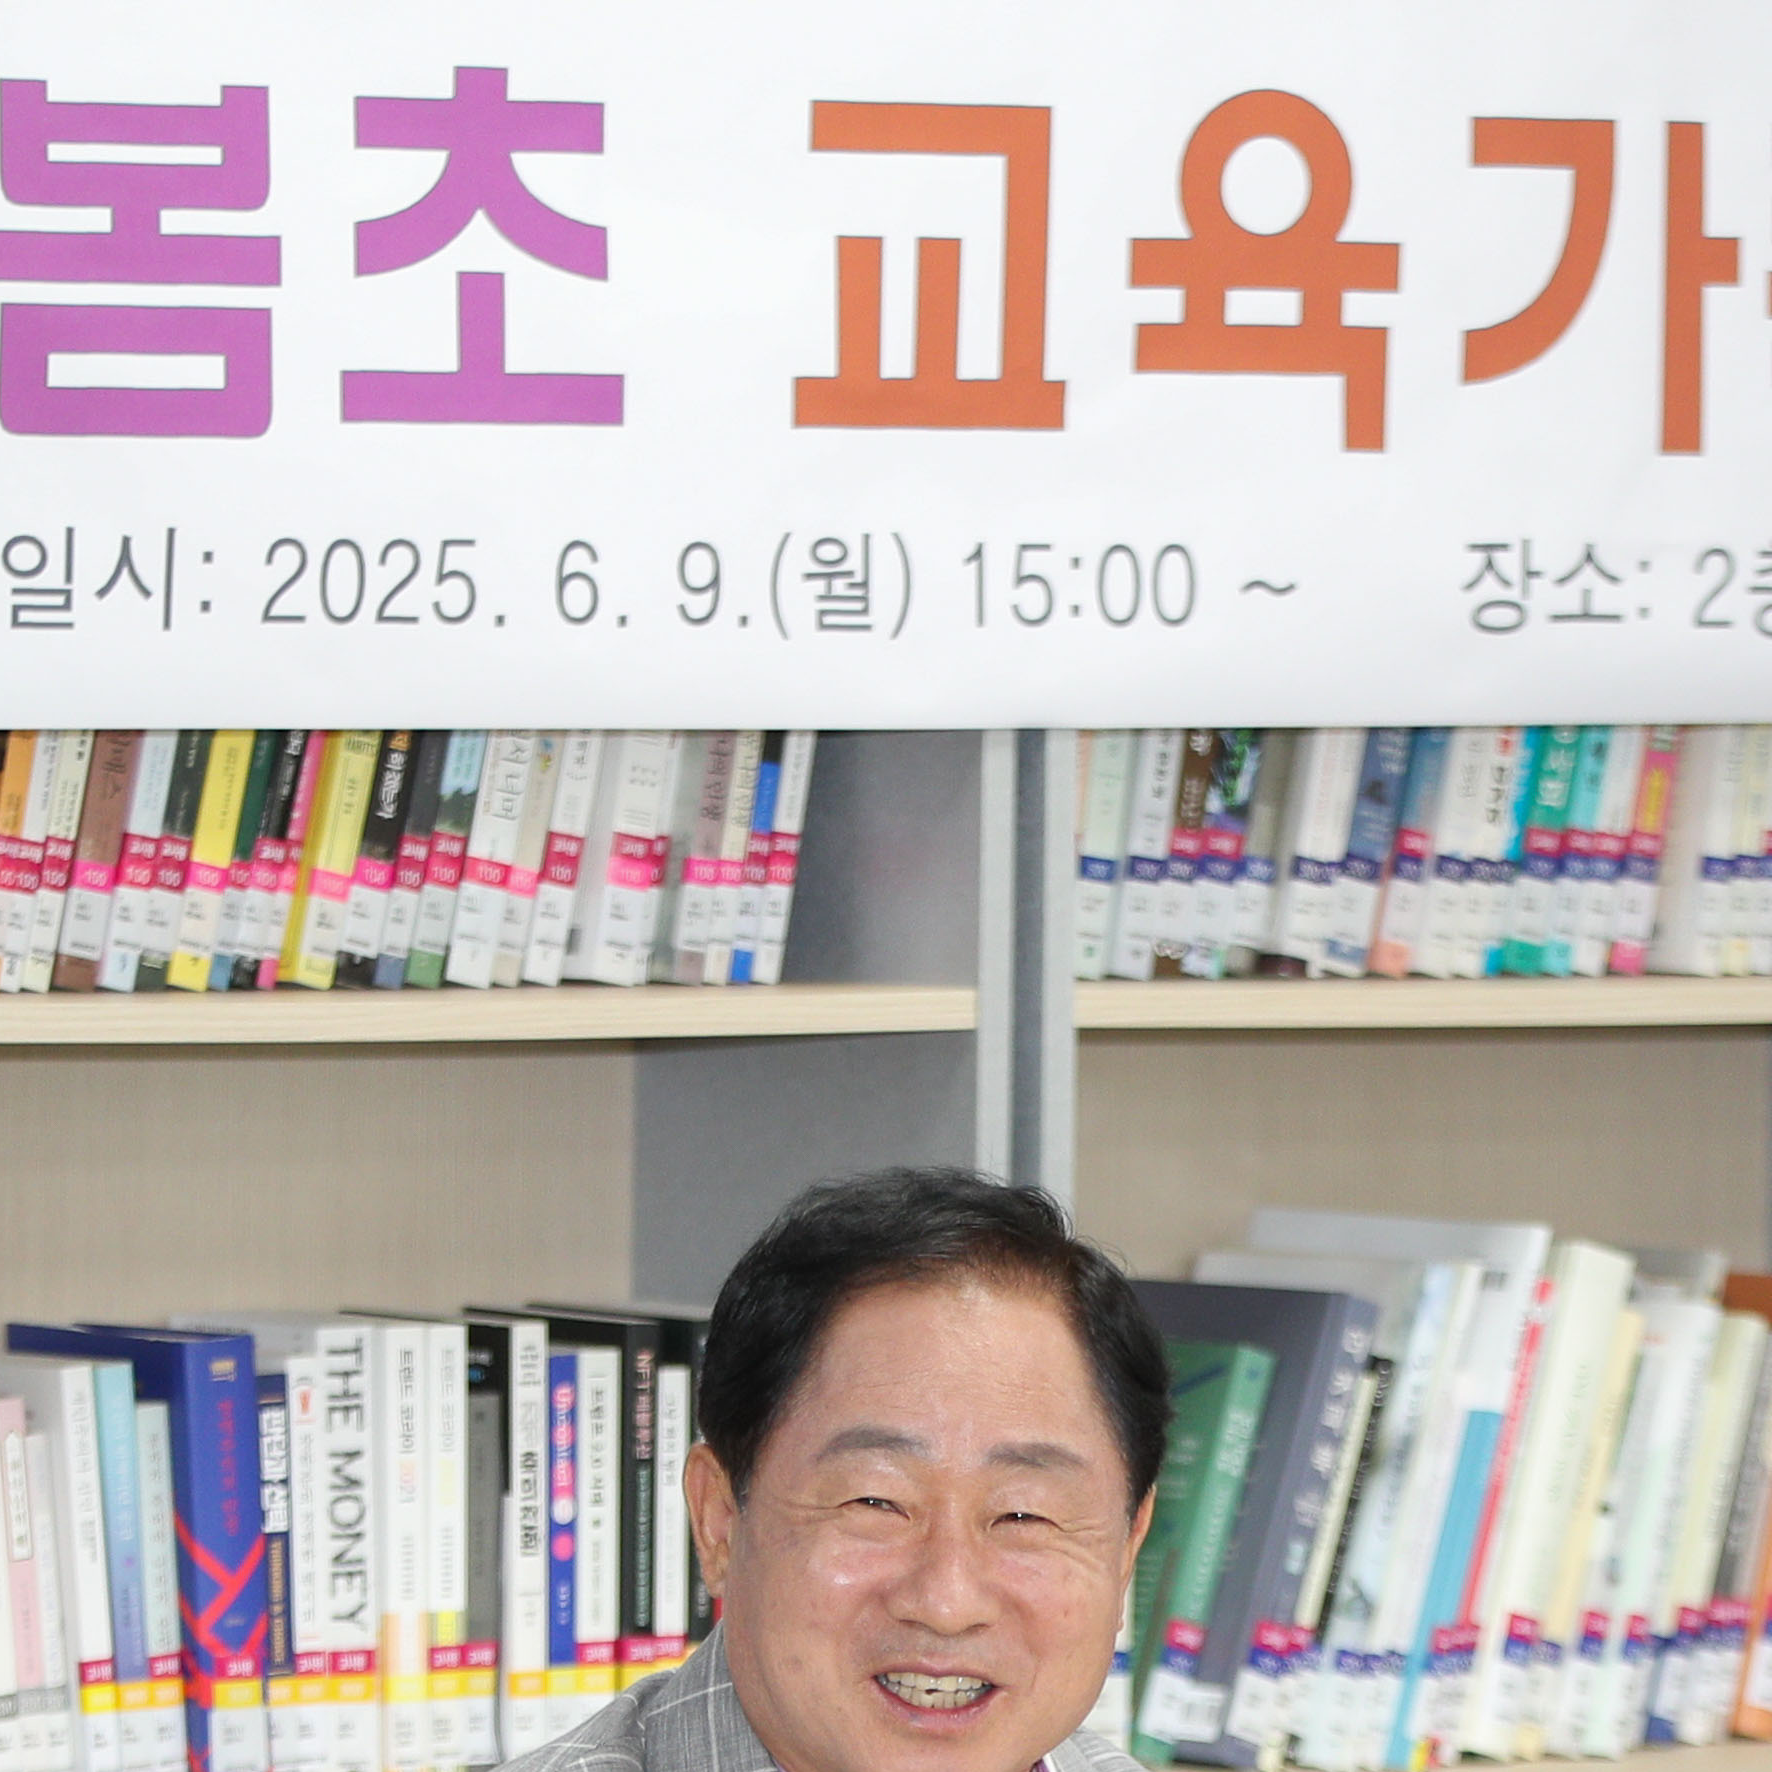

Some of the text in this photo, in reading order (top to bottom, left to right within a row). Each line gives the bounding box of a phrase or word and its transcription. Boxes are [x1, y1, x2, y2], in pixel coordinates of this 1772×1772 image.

[2, 527, 211, 628] 일시:
[263, 538, 503, 624] 2025.
[558, 540, 625, 624] 6.
[966, 544, 1188, 624] 15:00
[1464, 542, 1652, 634] 장소:
[324, 1336, 365, 1432] THE
[397, 1348, 415, 1400] 트렌드
[634, 1351, 653, 1391] NFT
[397, 1404, 415, 1454] 코리아
[326, 1449, 370, 1632] MONEY
